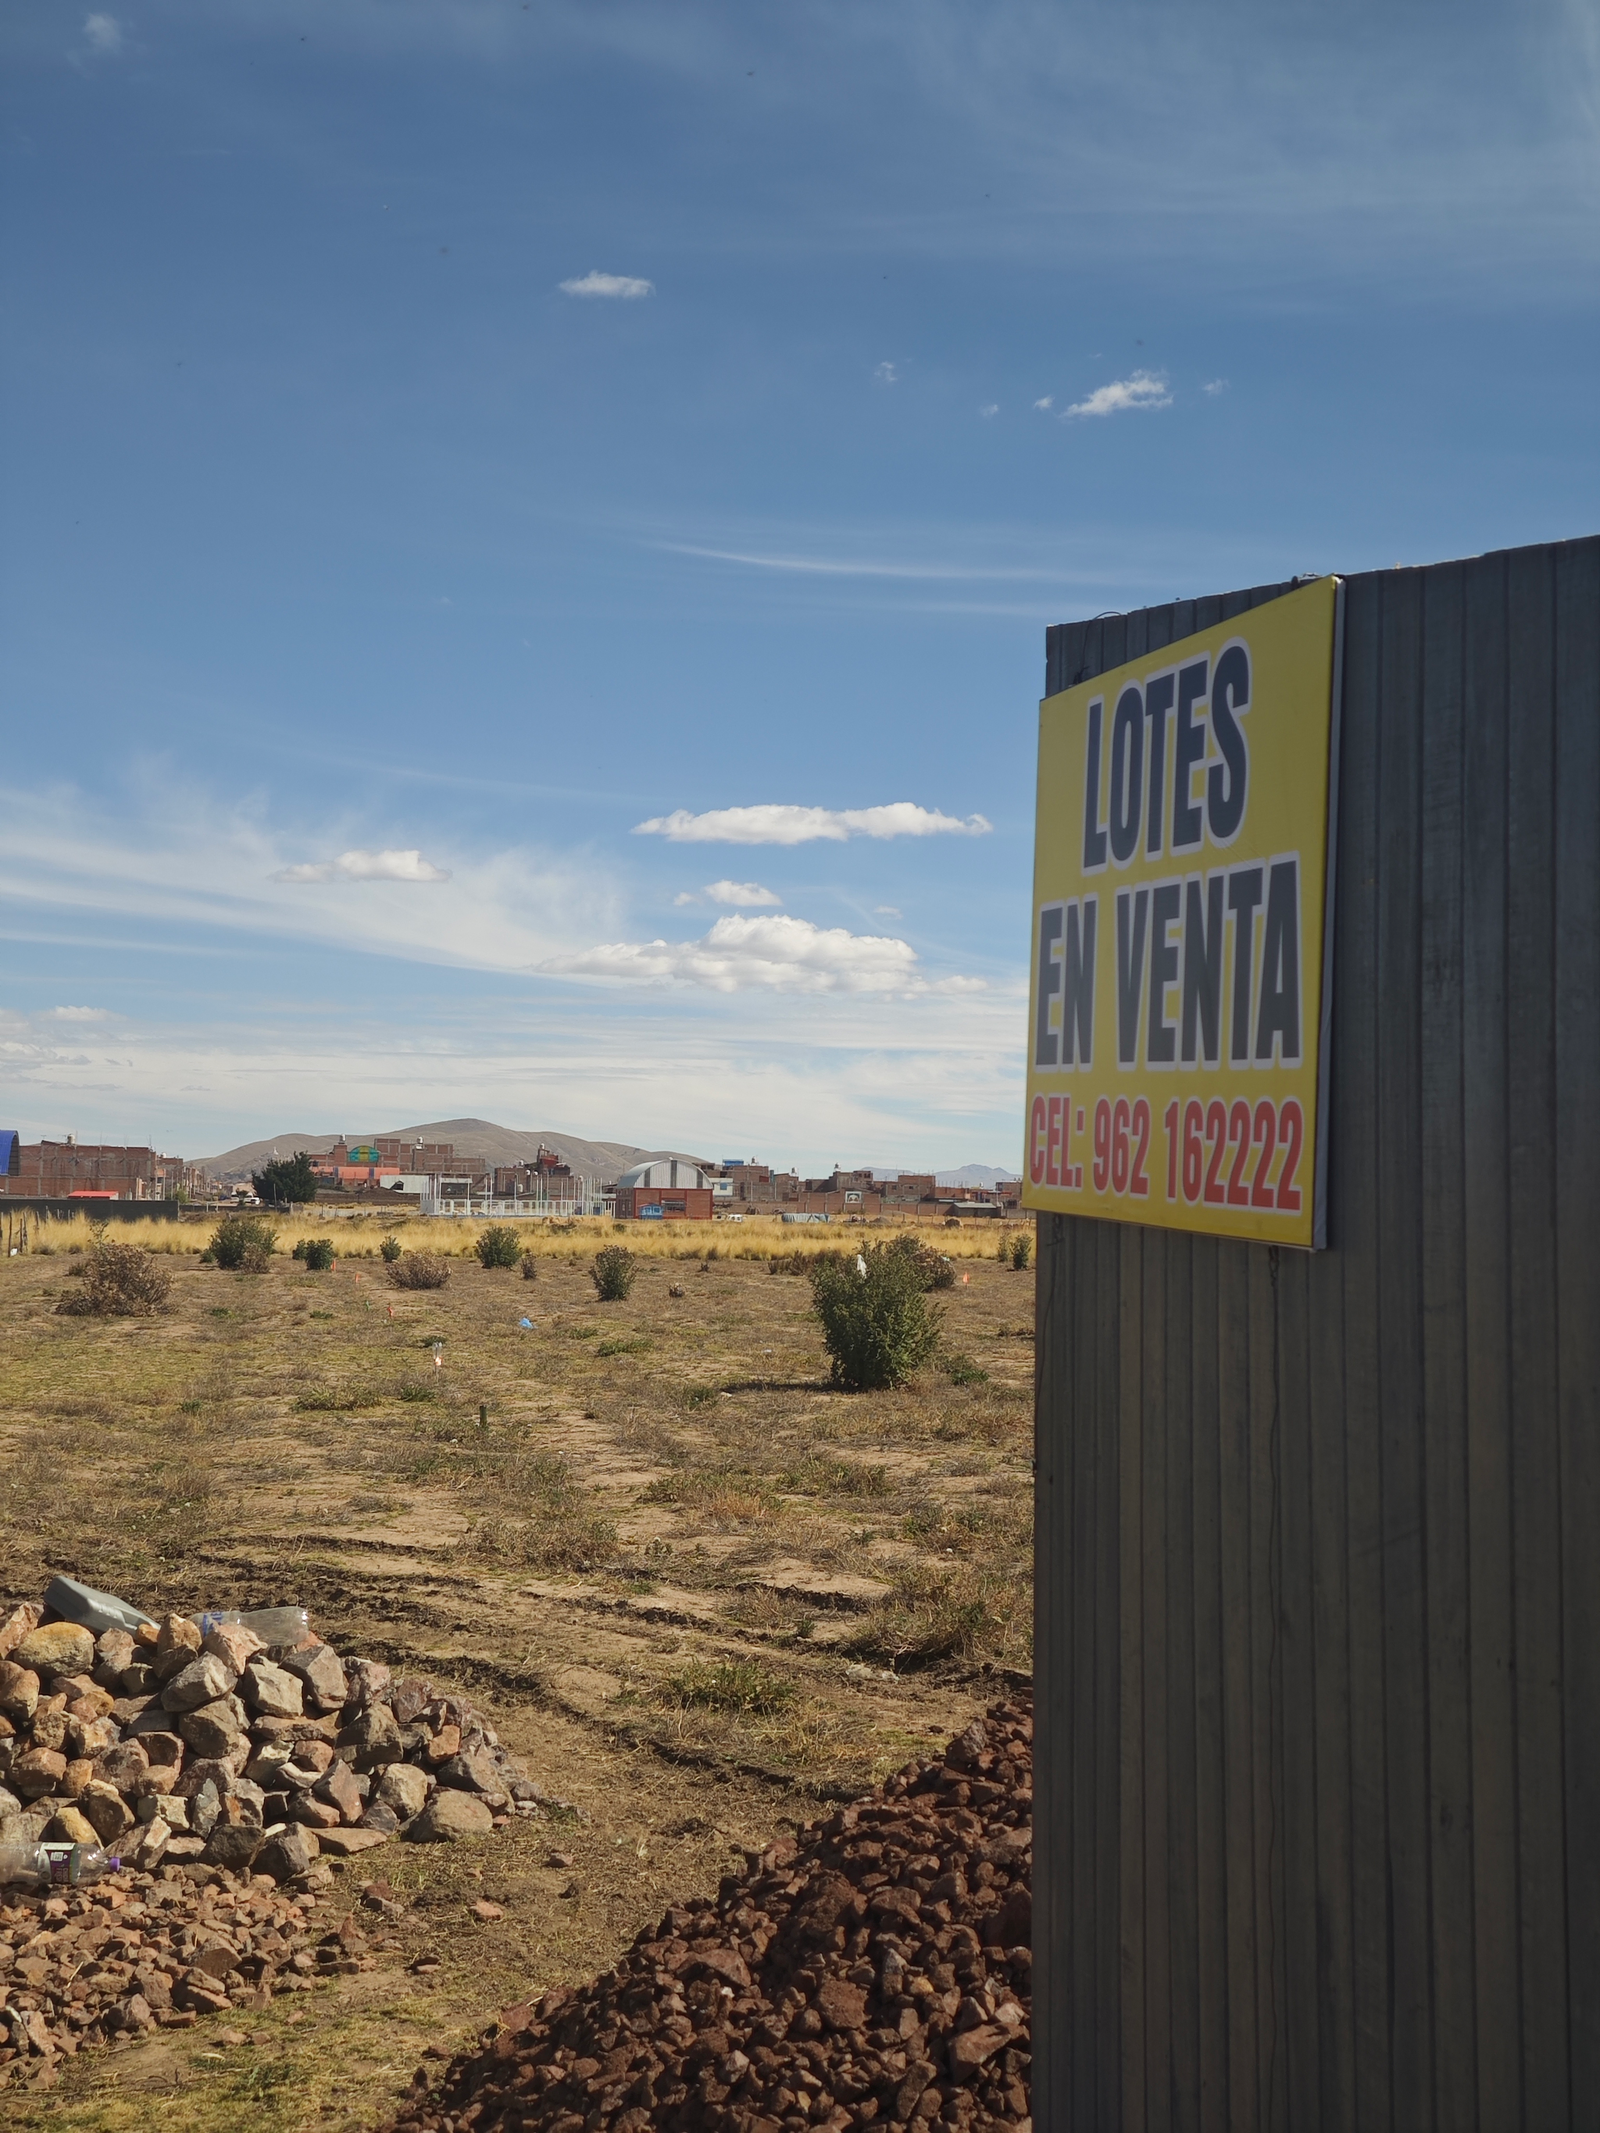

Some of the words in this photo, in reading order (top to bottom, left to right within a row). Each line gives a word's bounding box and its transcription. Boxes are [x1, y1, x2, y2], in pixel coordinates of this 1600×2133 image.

[1082, 643, 1251, 870] LOTES
[1034, 899, 1097, 1067] EN
[1116, 859, 1301, 1064] VENTA
[1029, 1096, 1084, 1188] CEL:
[1092, 1098, 1151, 1196] 962
[1164, 1100, 1303, 1211] 162222
